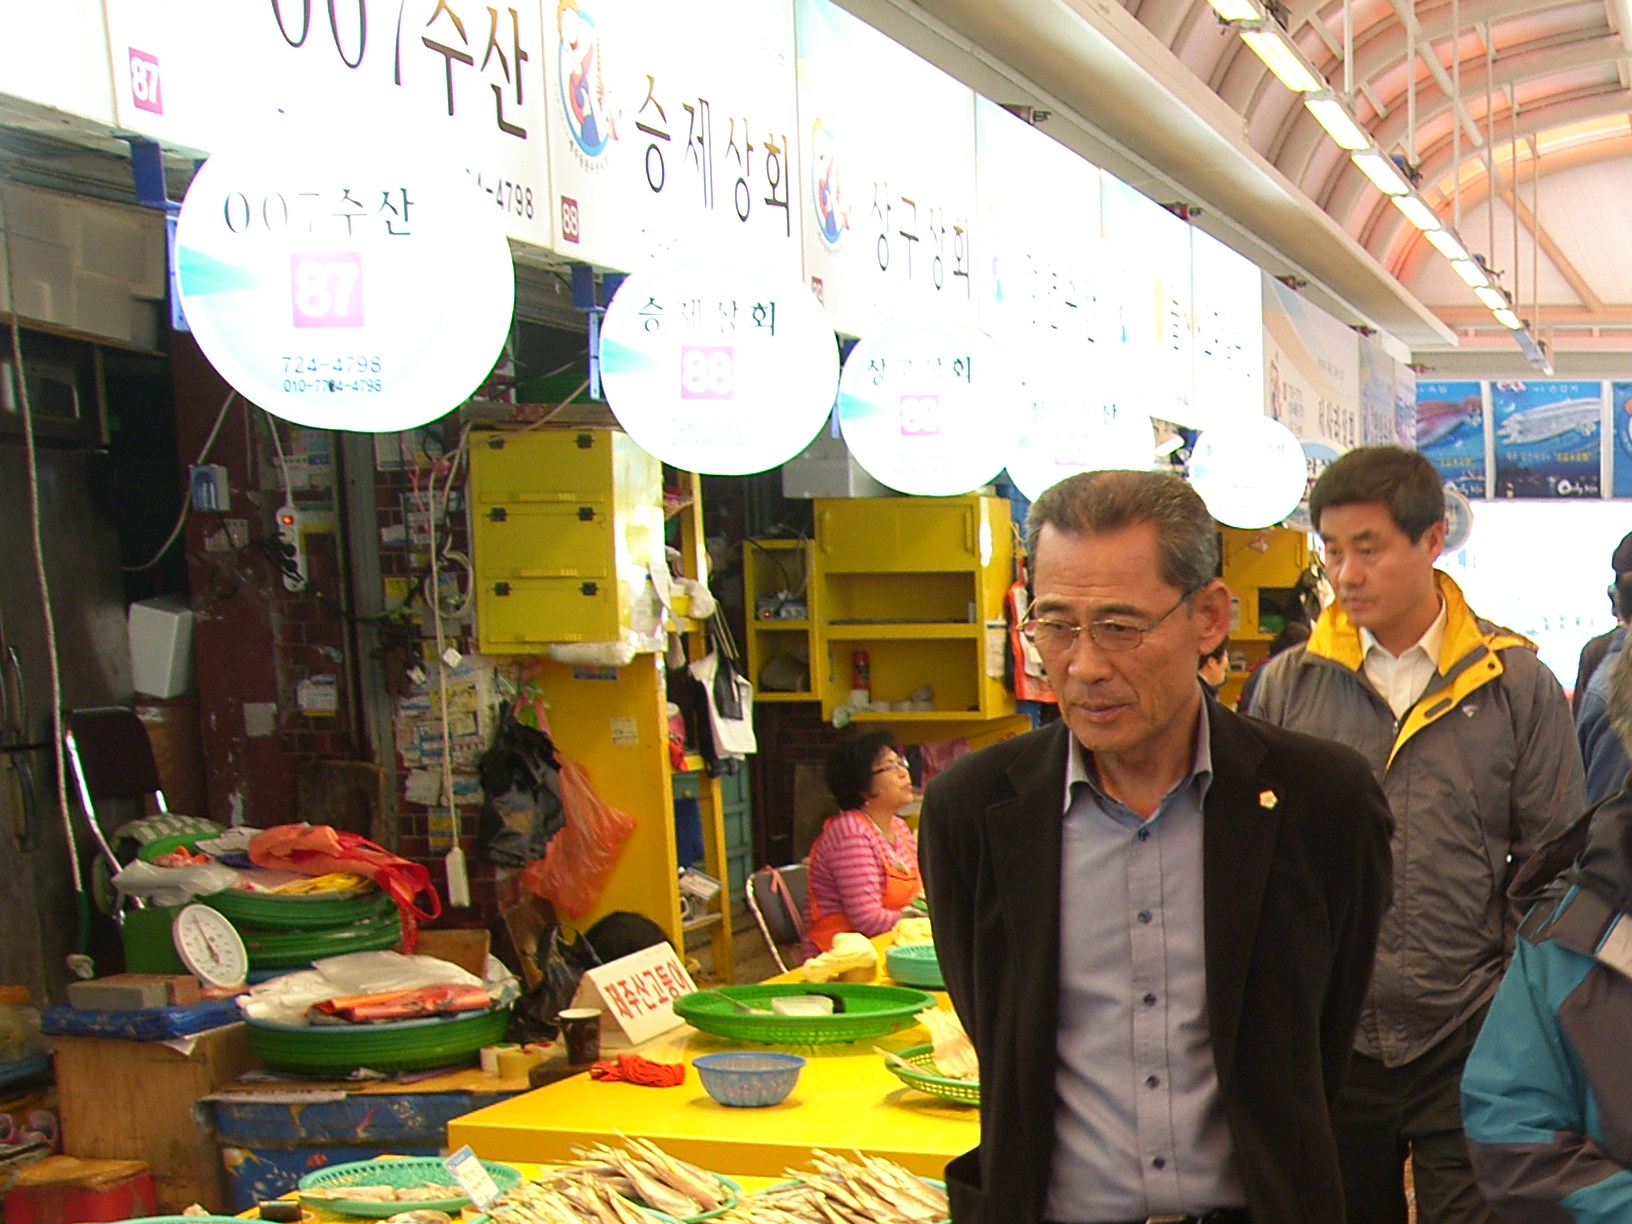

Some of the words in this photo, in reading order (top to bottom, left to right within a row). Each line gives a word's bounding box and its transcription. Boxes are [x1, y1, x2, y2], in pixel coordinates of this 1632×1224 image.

[131, 57, 158, 104] 87
[635, 74, 792, 238] 승제상회
[294, 259, 360, 319] 87
[637, 295, 777, 338] 승제상회
[281, 354, 383, 375] 724-4798
[282, 377, 383, 394] 010-774-4798
[603, 958, 696, 1020] 제주산고등어
